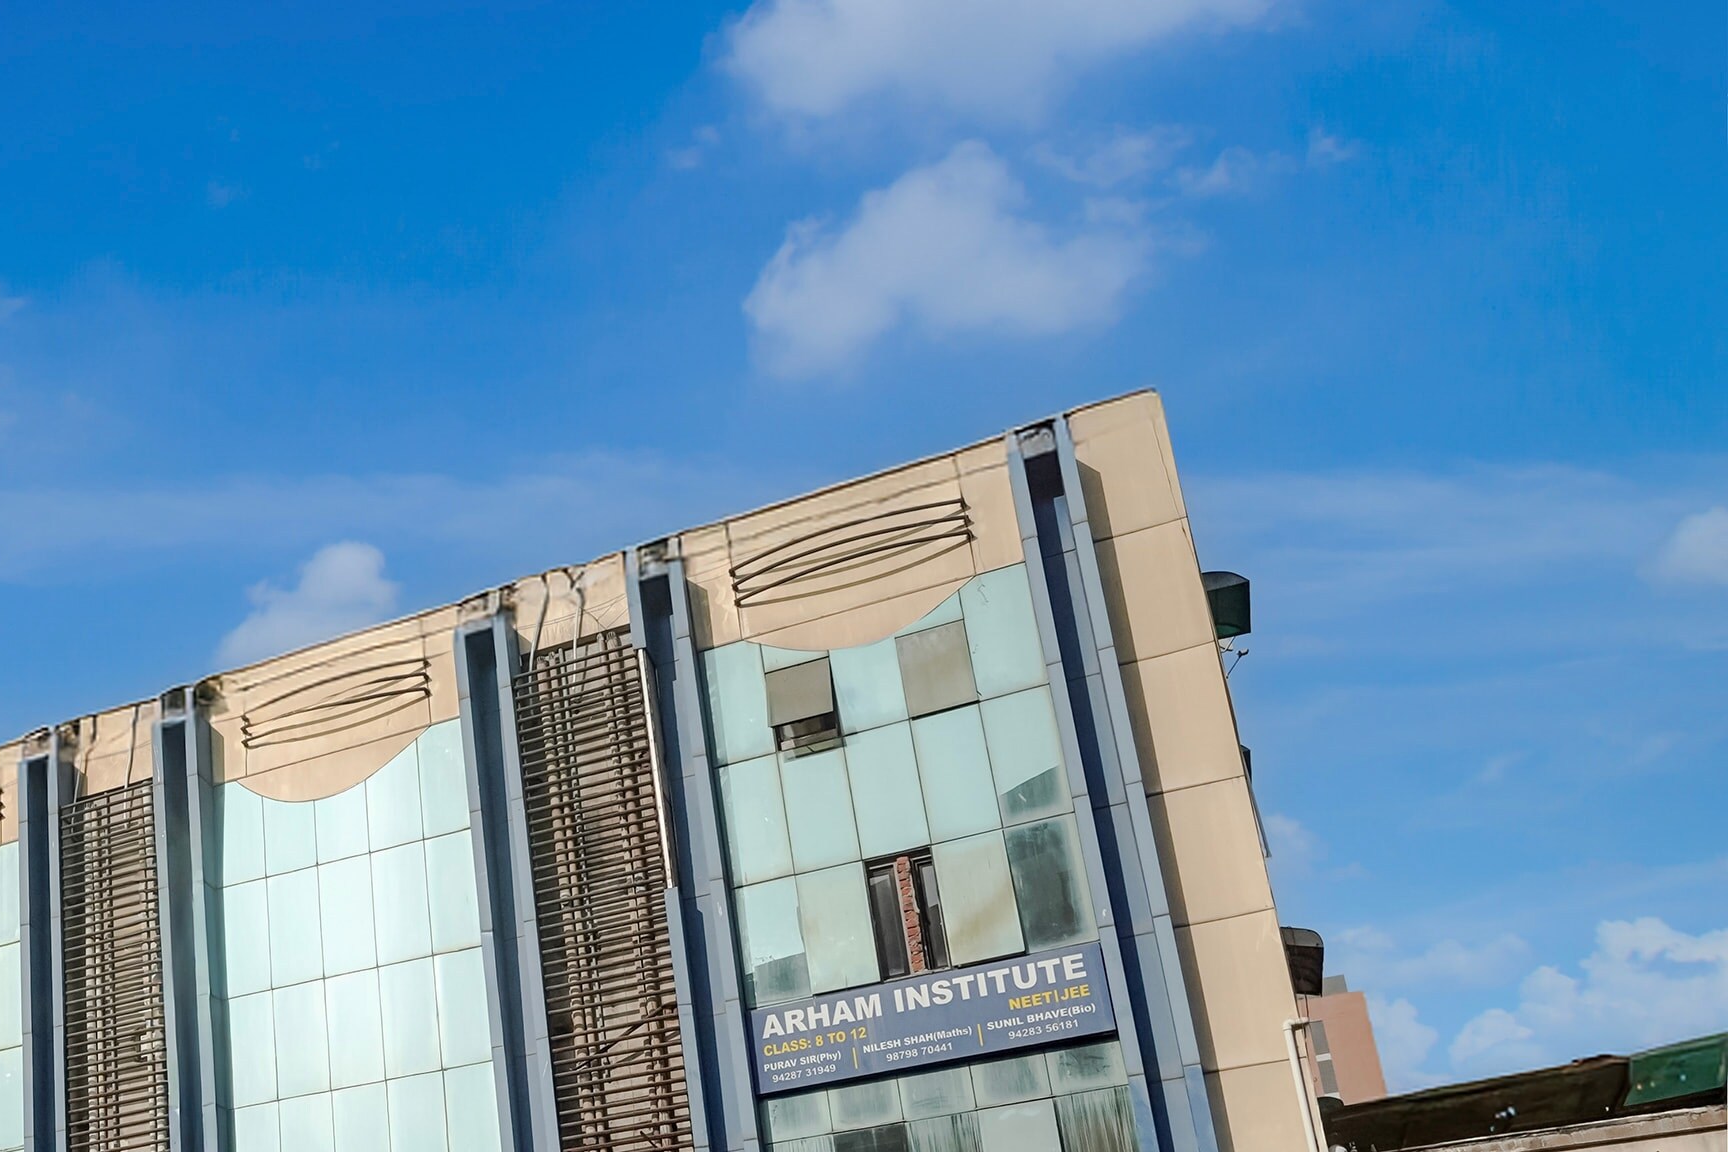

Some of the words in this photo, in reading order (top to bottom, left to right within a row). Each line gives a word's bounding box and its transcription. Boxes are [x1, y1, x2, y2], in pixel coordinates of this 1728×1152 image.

[762, 993, 883, 1039] ARHAM
[893, 953, 1088, 1013] INSTITUTE
[986, 1016, 1024, 1031] SUNIL
[1027, 1003, 1097, 1023] BHAVE(Bio)
[1008, 1026, 1042, 1040] 94283
[1045, 1019, 1079, 1033] 56181
[763, 1038, 812, 1057] CLASS:
[815, 1035, 824, 1047] 8
[827, 1031, 847, 1044] TO
[850, 1027, 867, 1041] 12
[863, 1038, 901, 1054] NILESH
[904, 1025, 973, 1047] SHAH(Maths)
[886, 1049, 919, 1062] 98798
[921, 1042, 953, 1056] 70441
[764, 1058, 797, 1072] PURAV
[799, 1050, 842, 1067] SIR(Phy)
[772, 1070, 802, 1083] 94287
[805, 1064, 836, 1077] 31949
